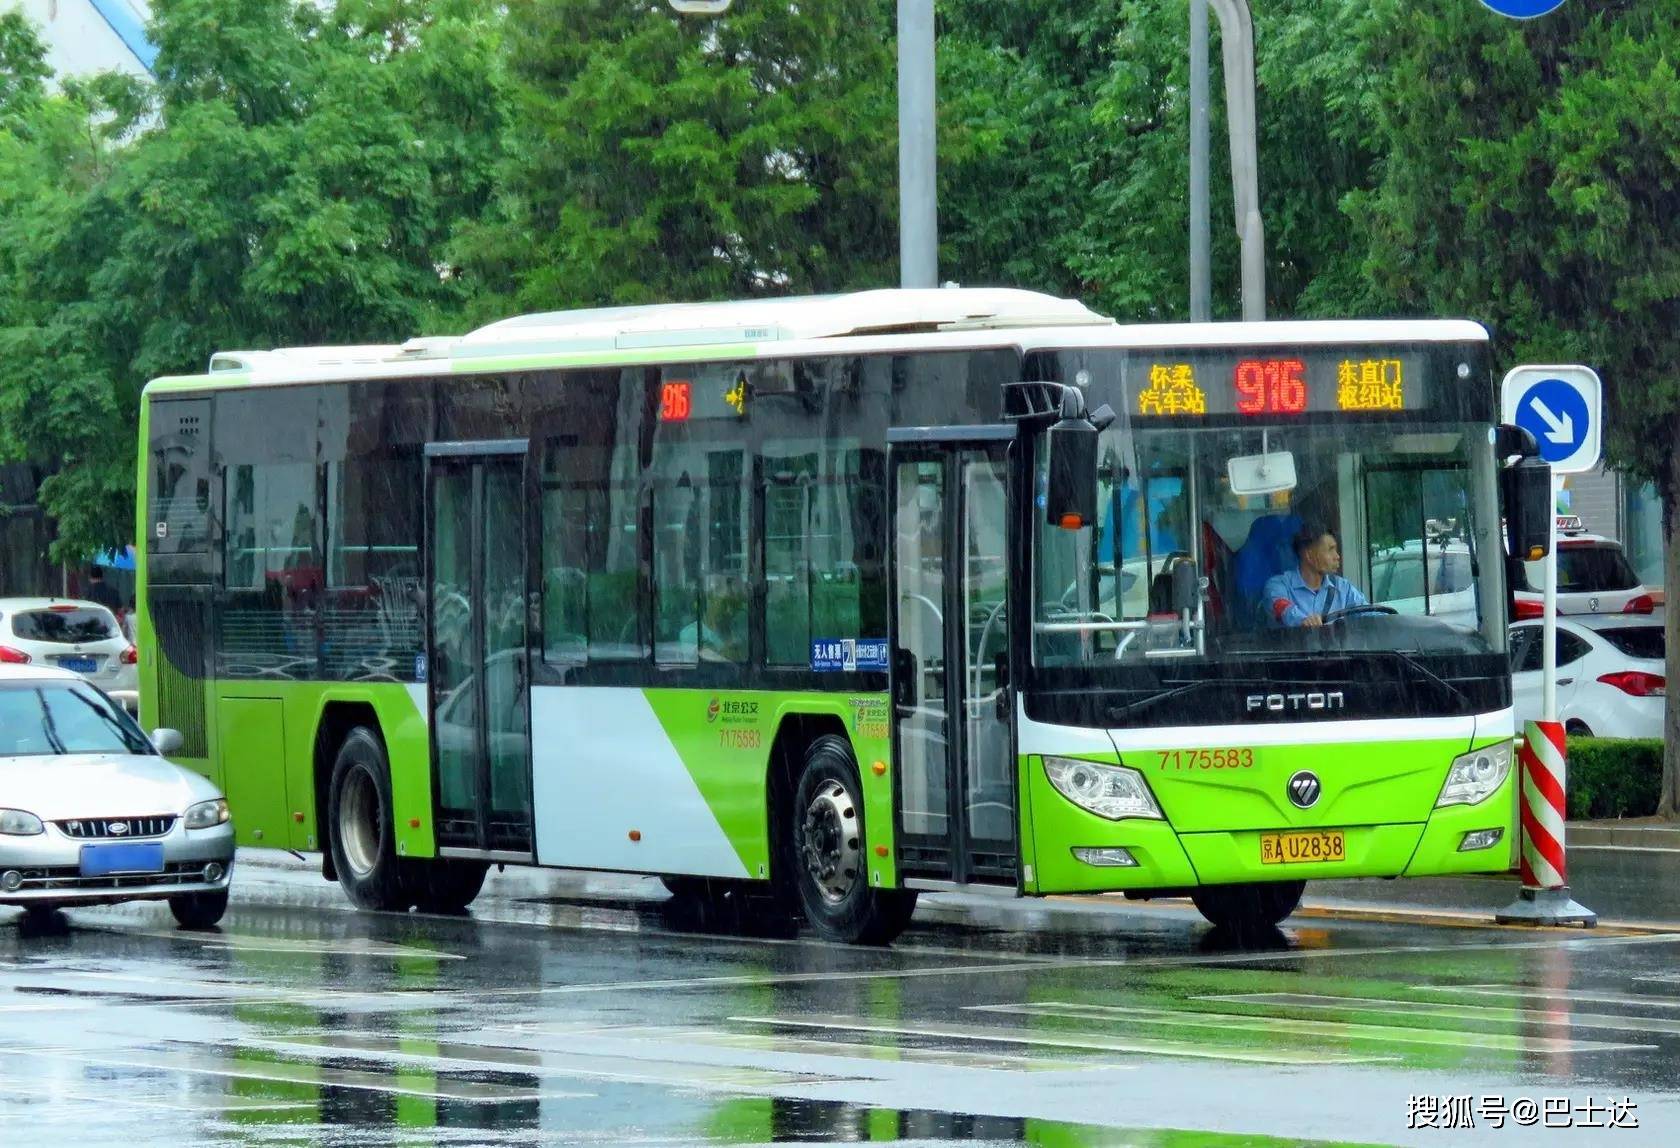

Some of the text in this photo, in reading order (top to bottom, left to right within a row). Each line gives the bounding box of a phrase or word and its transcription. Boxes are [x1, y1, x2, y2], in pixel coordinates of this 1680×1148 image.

[1150, 364, 1194, 390] 怀柔
[1338, 359, 1401, 385] 东直门
[1236, 359, 1305, 413] 916
[1338, 384, 1402, 410] 枢纽站
[662, 382, 690, 420] 916
[1139, 387, 1205, 414] 汽车站
[721, 700, 760, 714] 北京公交
[1246, 691, 1345, 711] FOTON
[1157, 749, 1253, 770] 7175583
